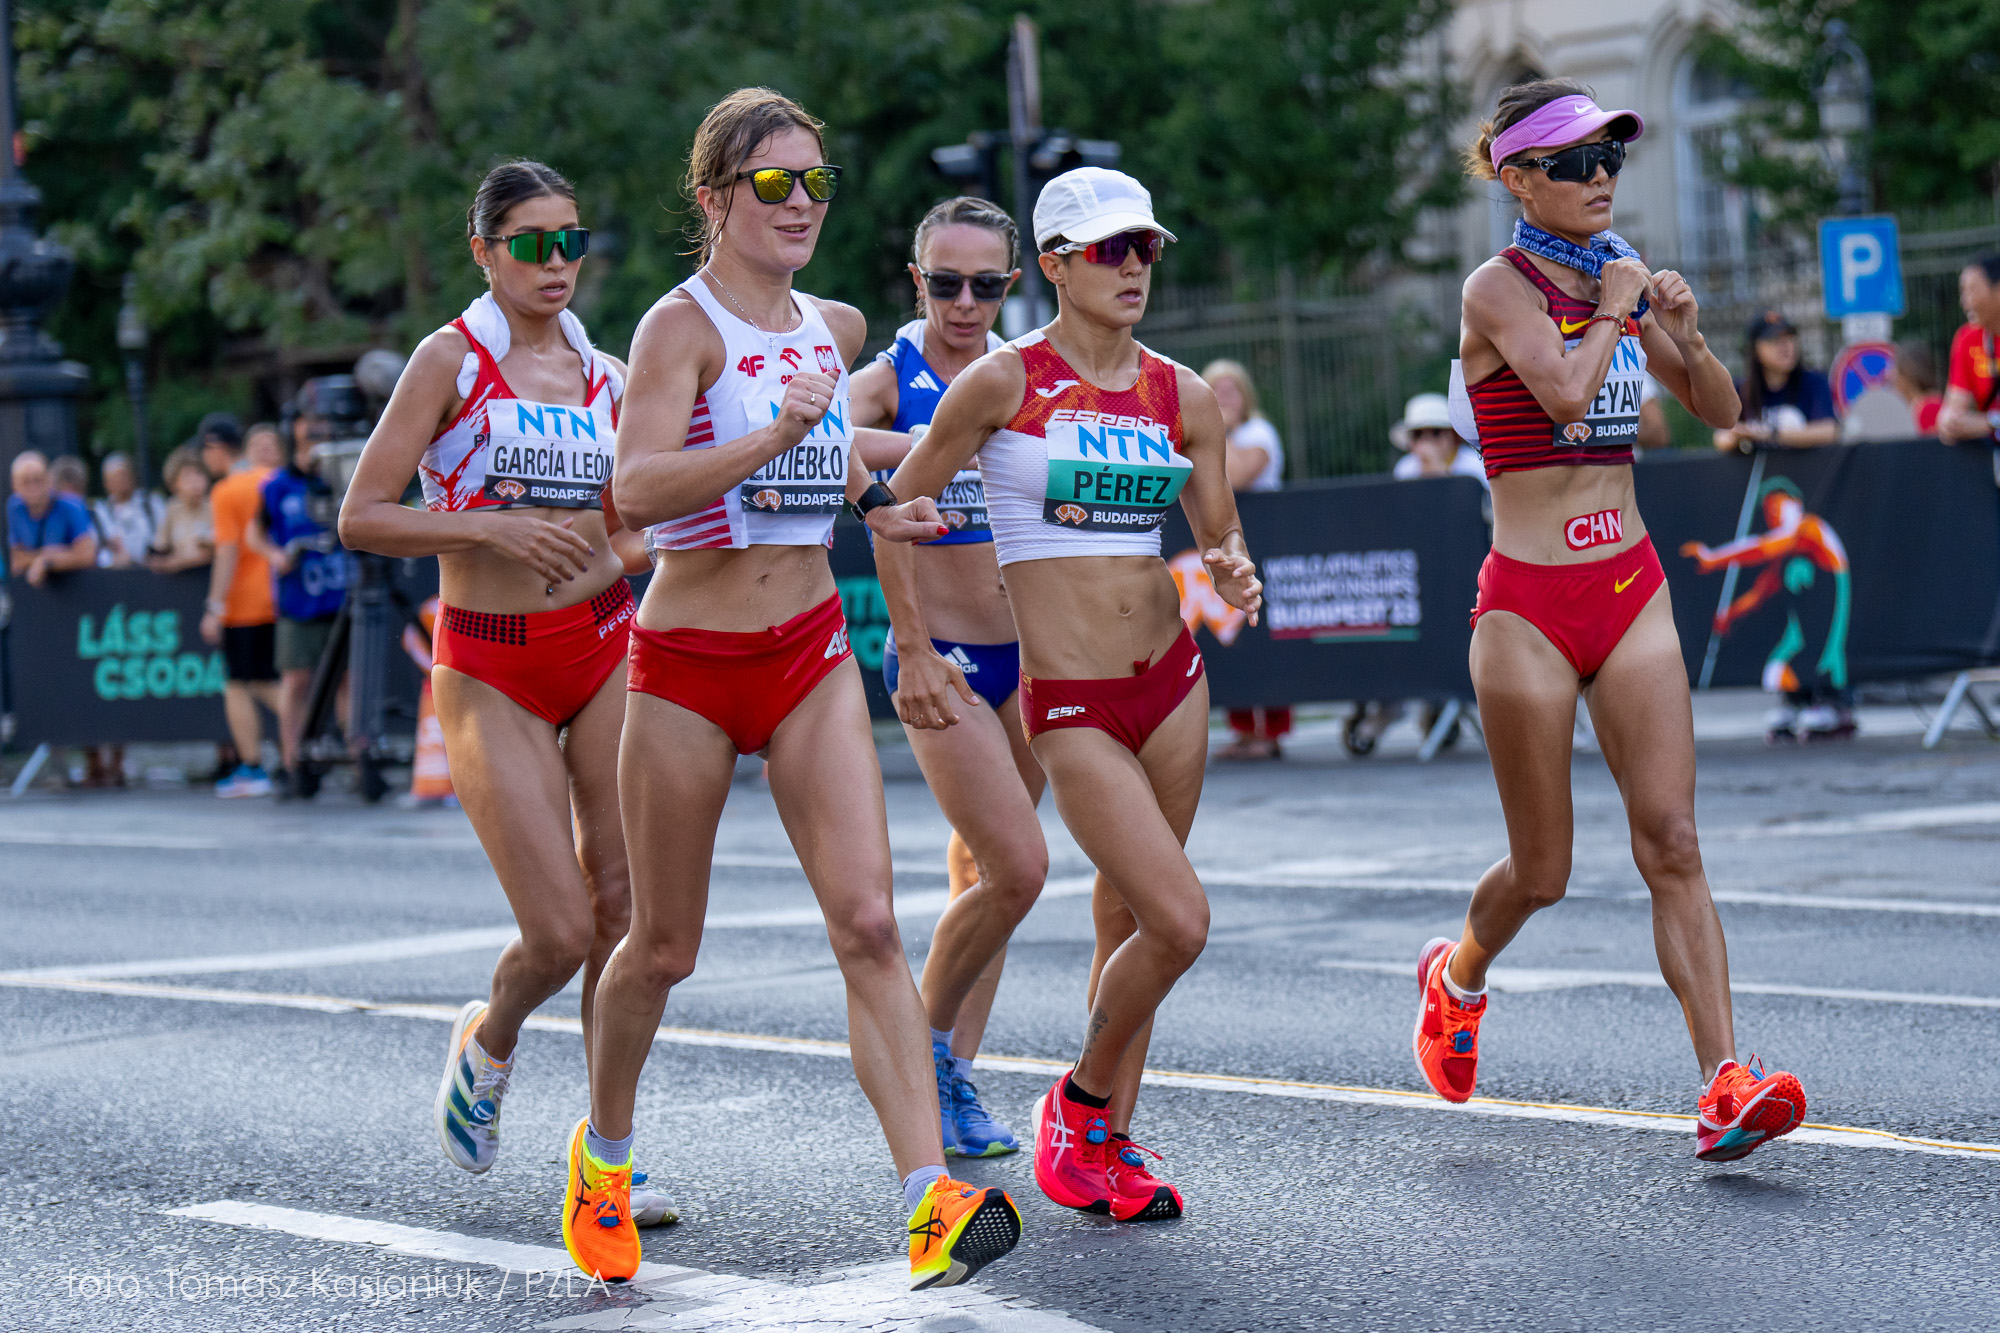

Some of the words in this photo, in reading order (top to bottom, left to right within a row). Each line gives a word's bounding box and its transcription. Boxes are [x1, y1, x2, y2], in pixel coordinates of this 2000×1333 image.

[1839, 232, 1883, 303] P
[737, 354, 765, 377] 4F
[516, 402, 597, 442] NTN
[493, 442, 566, 478] GARCÍA
[749, 444, 843, 481] DZIEBŁO
[1077, 424, 1170, 464] NTN
[1073, 465, 1172, 504] PÉREZ
[1567, 510, 1623, 547] CHN
[79, 603, 178, 659] LÁSS
[1046, 705, 1086, 720] ESP
